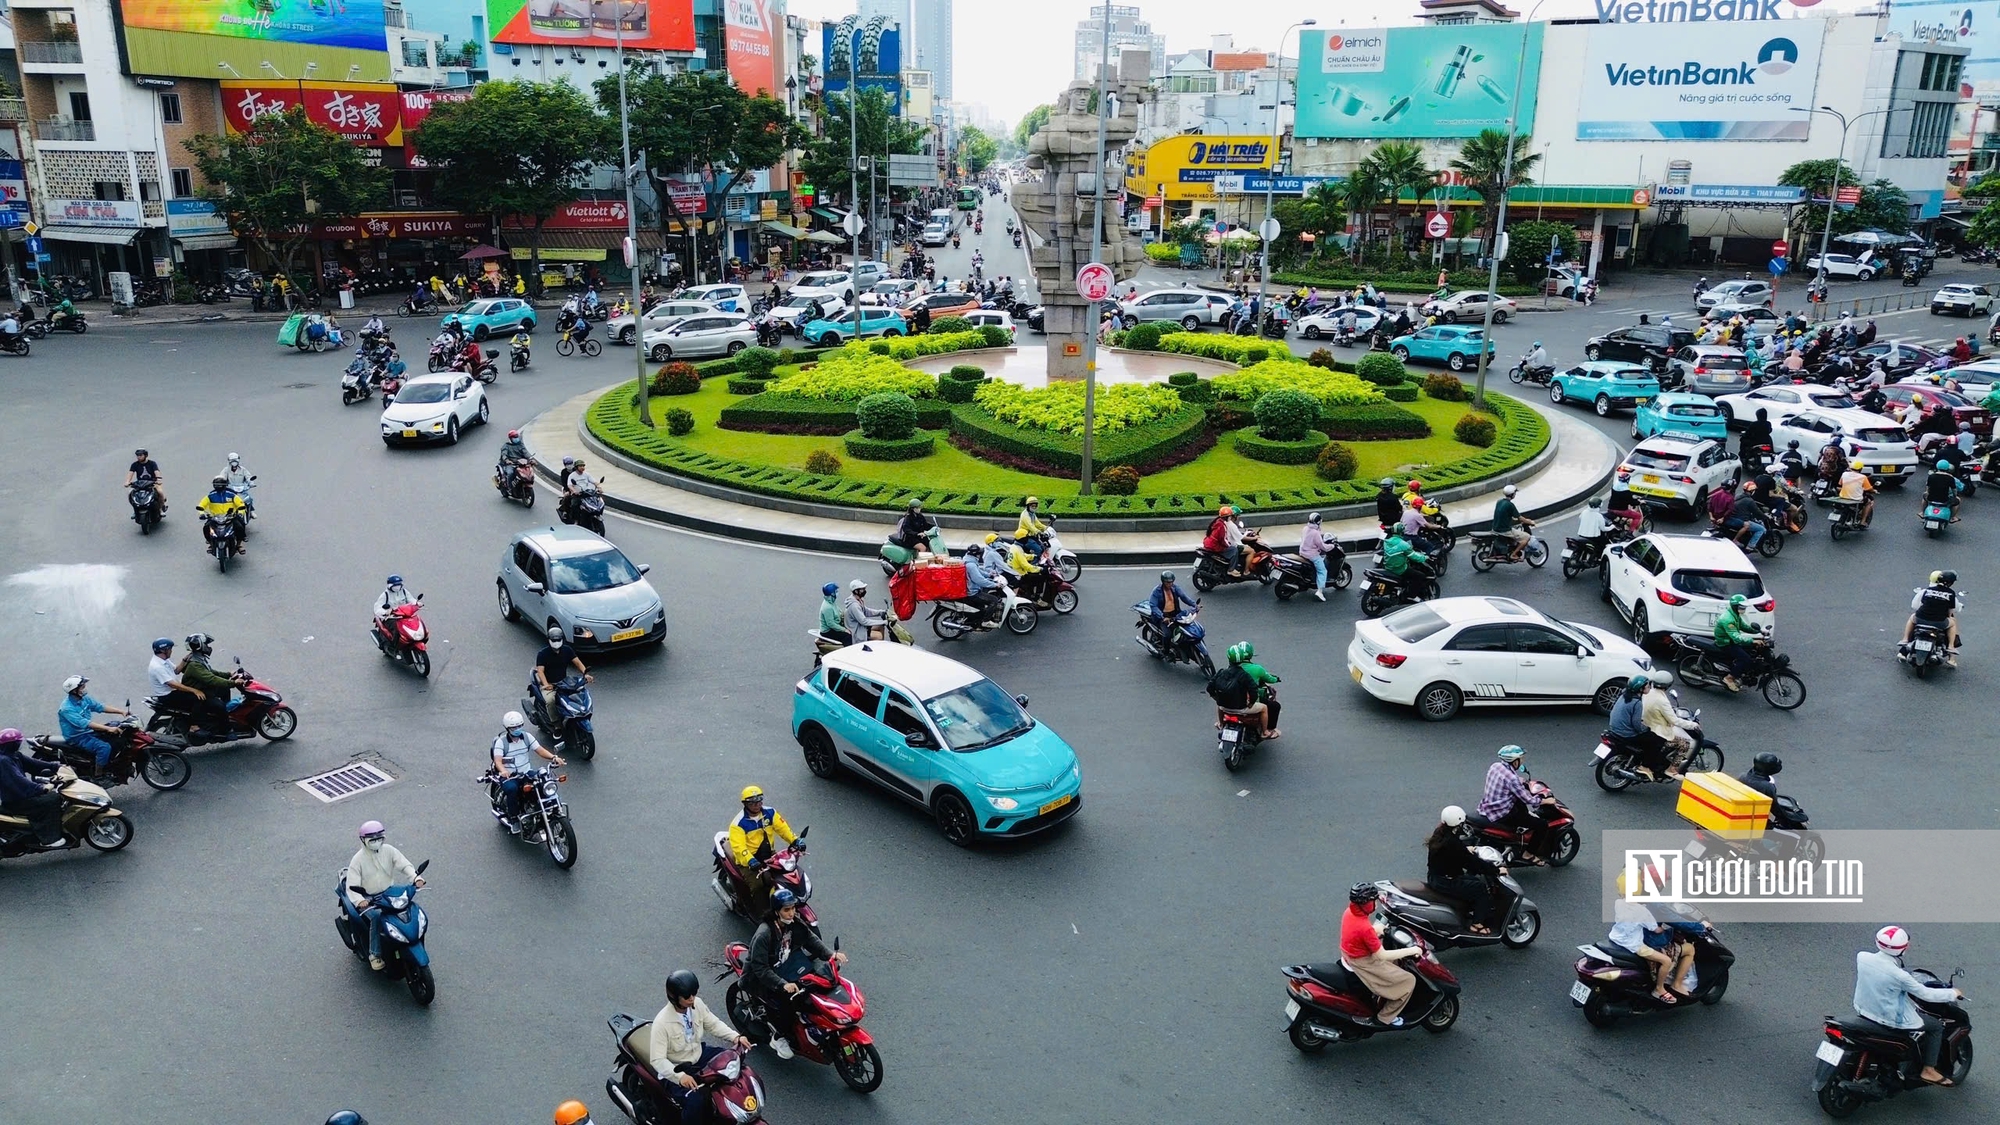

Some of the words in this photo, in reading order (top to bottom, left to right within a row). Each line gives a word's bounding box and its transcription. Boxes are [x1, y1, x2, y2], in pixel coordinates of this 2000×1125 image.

[1913, 20, 1958, 42] VietinBank
[1345, 36, 1381, 48] elmich
[1605, 61, 1757, 86] VietinBank
[1679, 93, 1706, 105] Nâng
[1708, 93, 1725, 104] giá
[1726, 93, 1737, 104] trị
[1738, 93, 1764, 104] cuộc
[1766, 92, 1791, 104] sống
[324, 91, 384, 133] すき家
[341, 133, 373, 141] SUKIYA
[1208, 141, 1231, 155] HẢI
[1658, 186, 1686, 195] Mobil
[1695, 188, 1710, 196] KHU
[566, 207, 608, 217] Vietlott
[404, 220, 453, 232] SUKIYA
